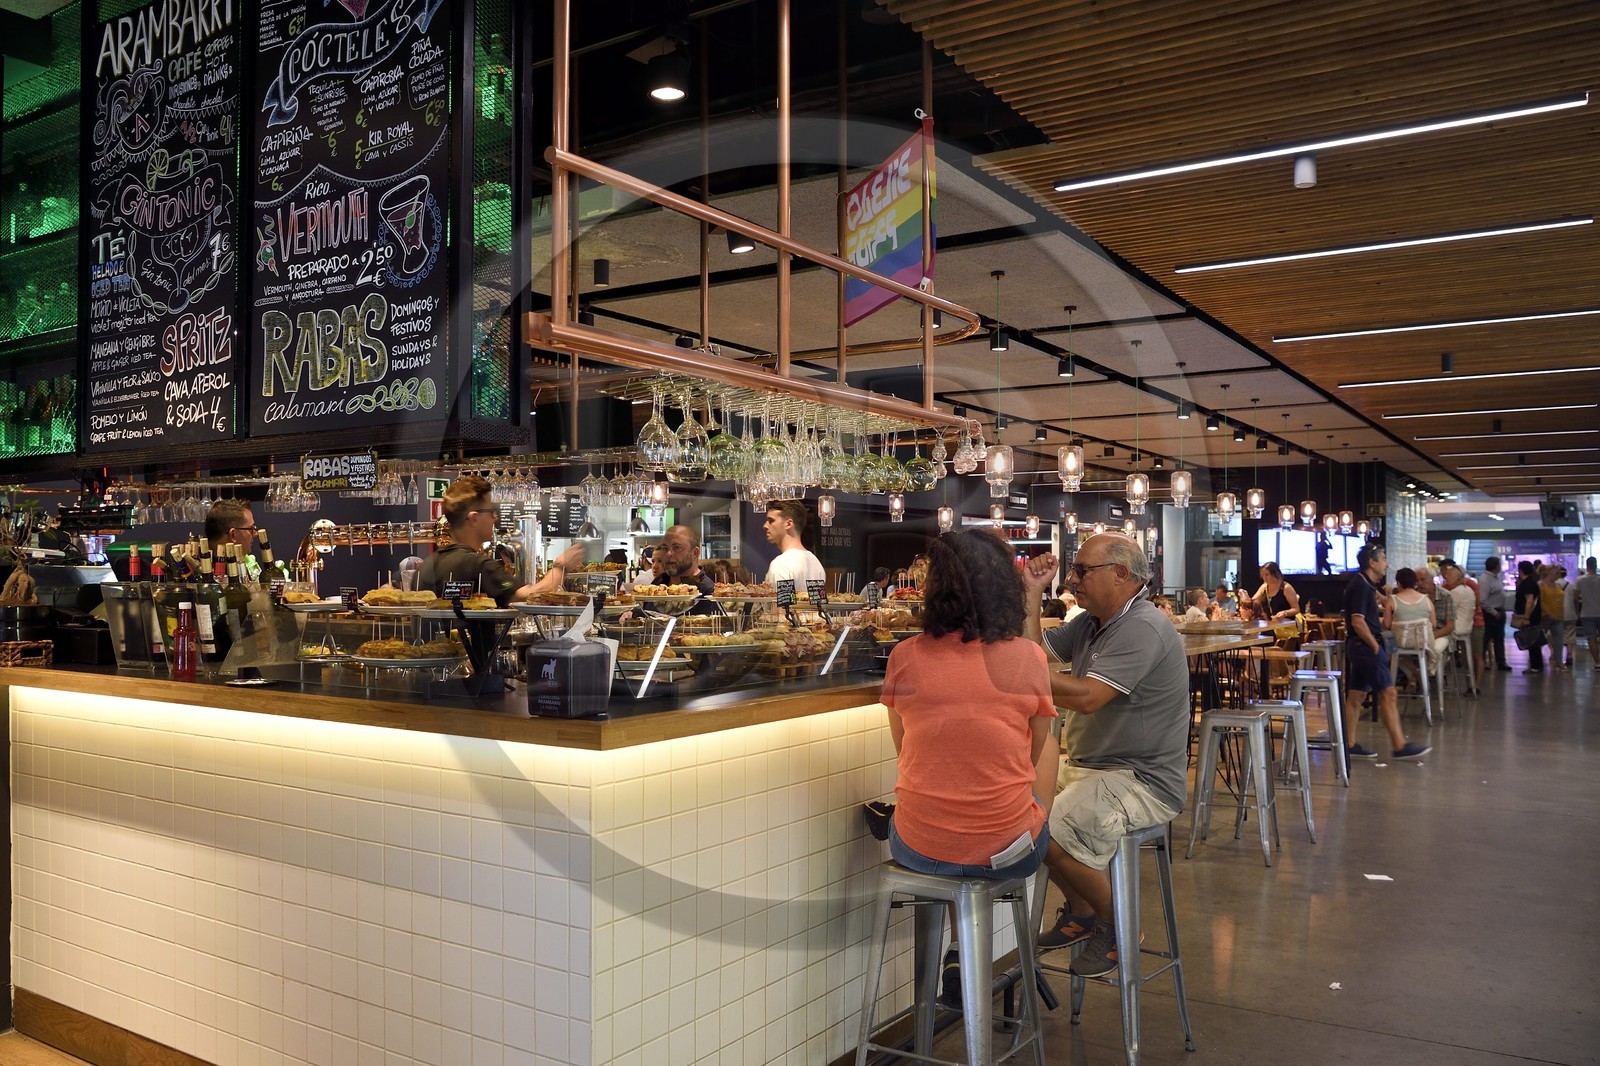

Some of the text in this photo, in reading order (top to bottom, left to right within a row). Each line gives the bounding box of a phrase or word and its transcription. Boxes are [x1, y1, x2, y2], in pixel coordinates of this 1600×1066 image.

[288, 0, 411, 84] CÓCTELES
[411, 36, 432, 55] PIÑA
[168, 47, 202, 83] CAFÉ
[206, 53, 226, 69] HOT
[408, 45, 444, 69] COLADA
[308, 80, 337, 95] TEQUILA
[375, 97, 395, 111] VODKA
[368, 120, 414, 147] KIR ROYAL
[364, 150, 380, 162] CAVA
[389, 136, 414, 154] CASSIS
[277, 186, 369, 263] VERMOUTH
[92, 229, 126, 264] TÉ
[92, 260, 118, 280] HELADO
[287, 254, 350, 281] PREPARADO
[321, 274, 347, 286] CARPANO
[119, 296, 141, 312] VIOLETA
[291, 289, 325, 300] ANGOSTURA
[91, 318, 111, 333] violet
[134, 310, 146, 325] iced
[146, 311, 160, 323] tea
[390, 316, 432, 337] FESTIVOS
[262, 292, 389, 397] RABAS
[390, 295, 433, 322] DOMINGOS
[391, 341, 431, 356] SUNDAYS
[91, 361, 106, 373] APPLE
[391, 353, 431, 371] HOLIDAYS
[189, 372, 231, 397] APEROL
[166, 404, 174, 425] &
[176, 401, 209, 427] SODA
[154, 427, 164, 435] TEA
[303, 455, 350, 480] RABAS
